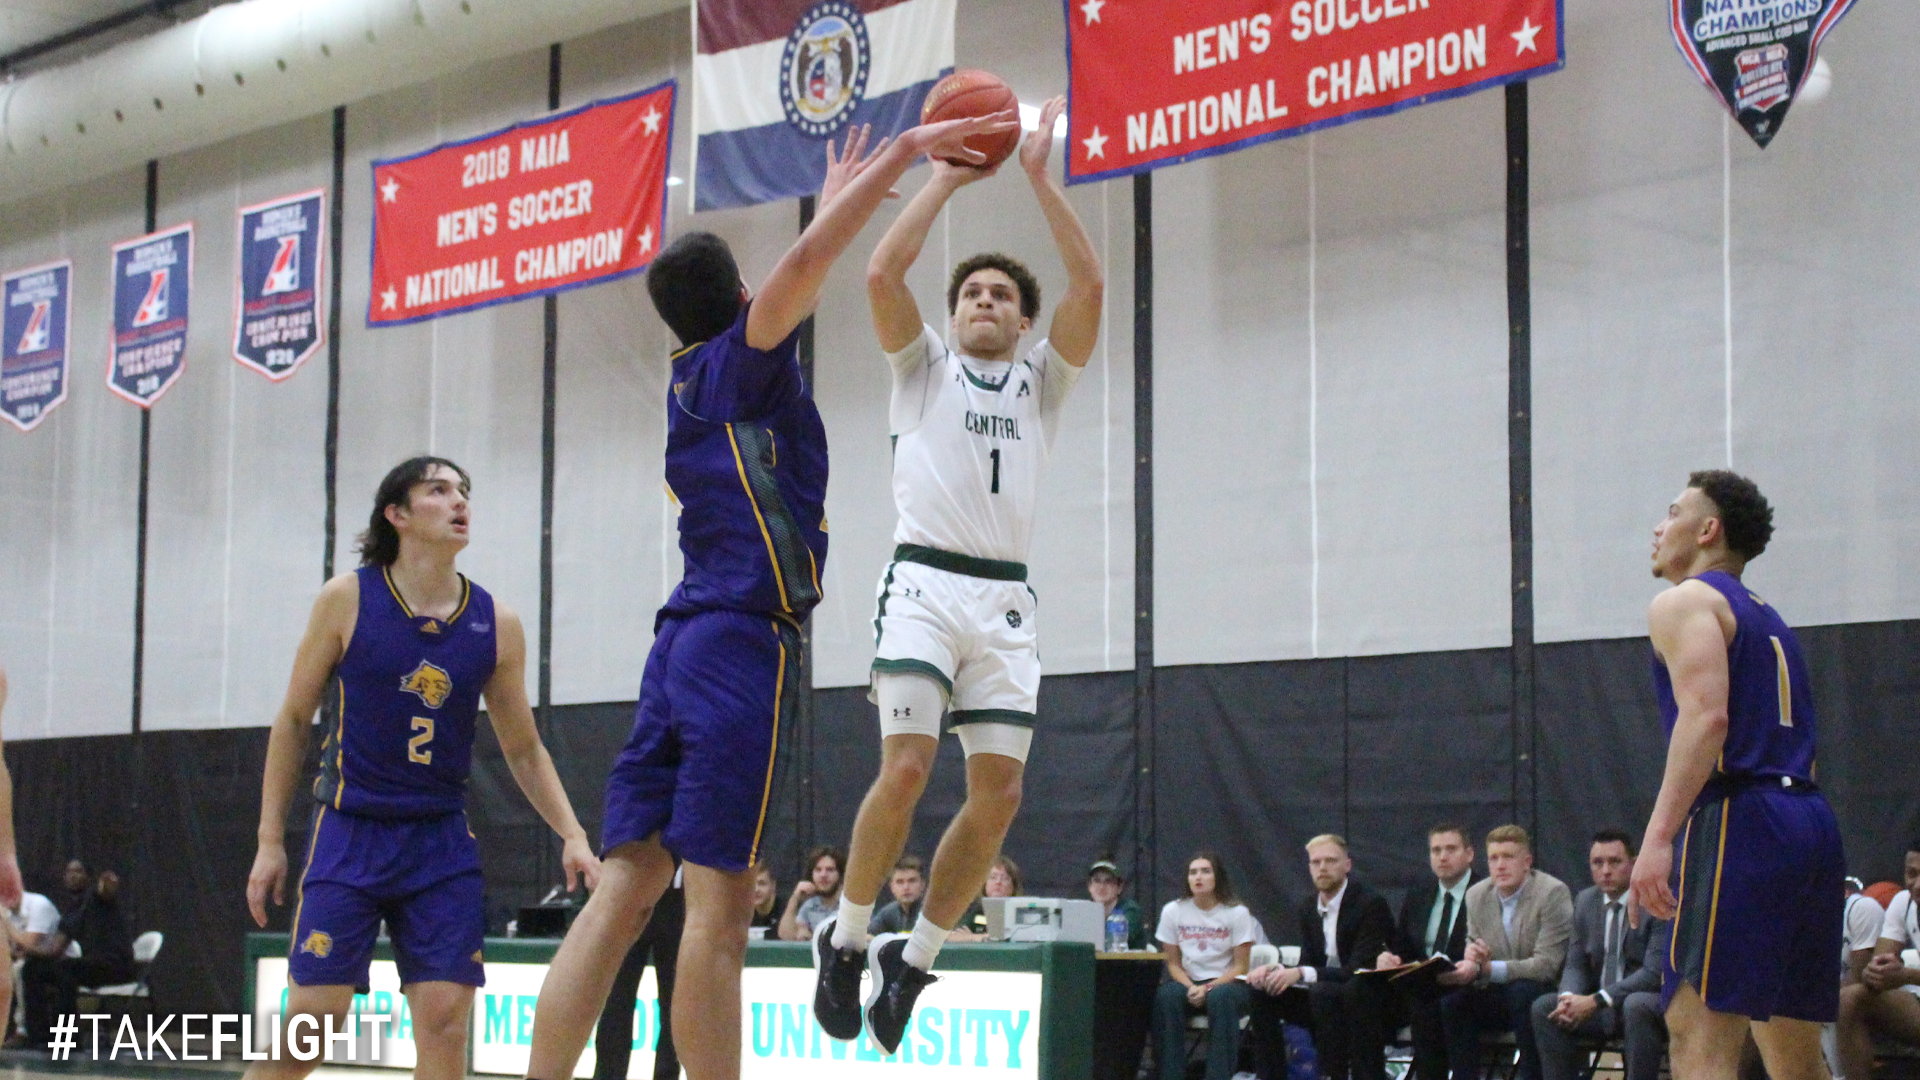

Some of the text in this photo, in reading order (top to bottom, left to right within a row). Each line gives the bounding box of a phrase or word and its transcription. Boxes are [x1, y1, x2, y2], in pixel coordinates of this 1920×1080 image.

[1173, 14, 1271, 75] MEN'S
[1696, 0, 1819, 37] CHAMPIONS
[1126, 24, 1486, 154] NATIONAL CHAMPION
[461, 129, 570, 188] 2018 NAIA
[436, 179, 593, 248] MEN'S SOCCER
[404, 227, 624, 309] NATIONAL CHAMPION
[965, 410, 1021, 440] CENTRAL
[990, 448, 1000, 494] 1
[1769, 635, 1793, 727] 1
[408, 716, 434, 765] 2
